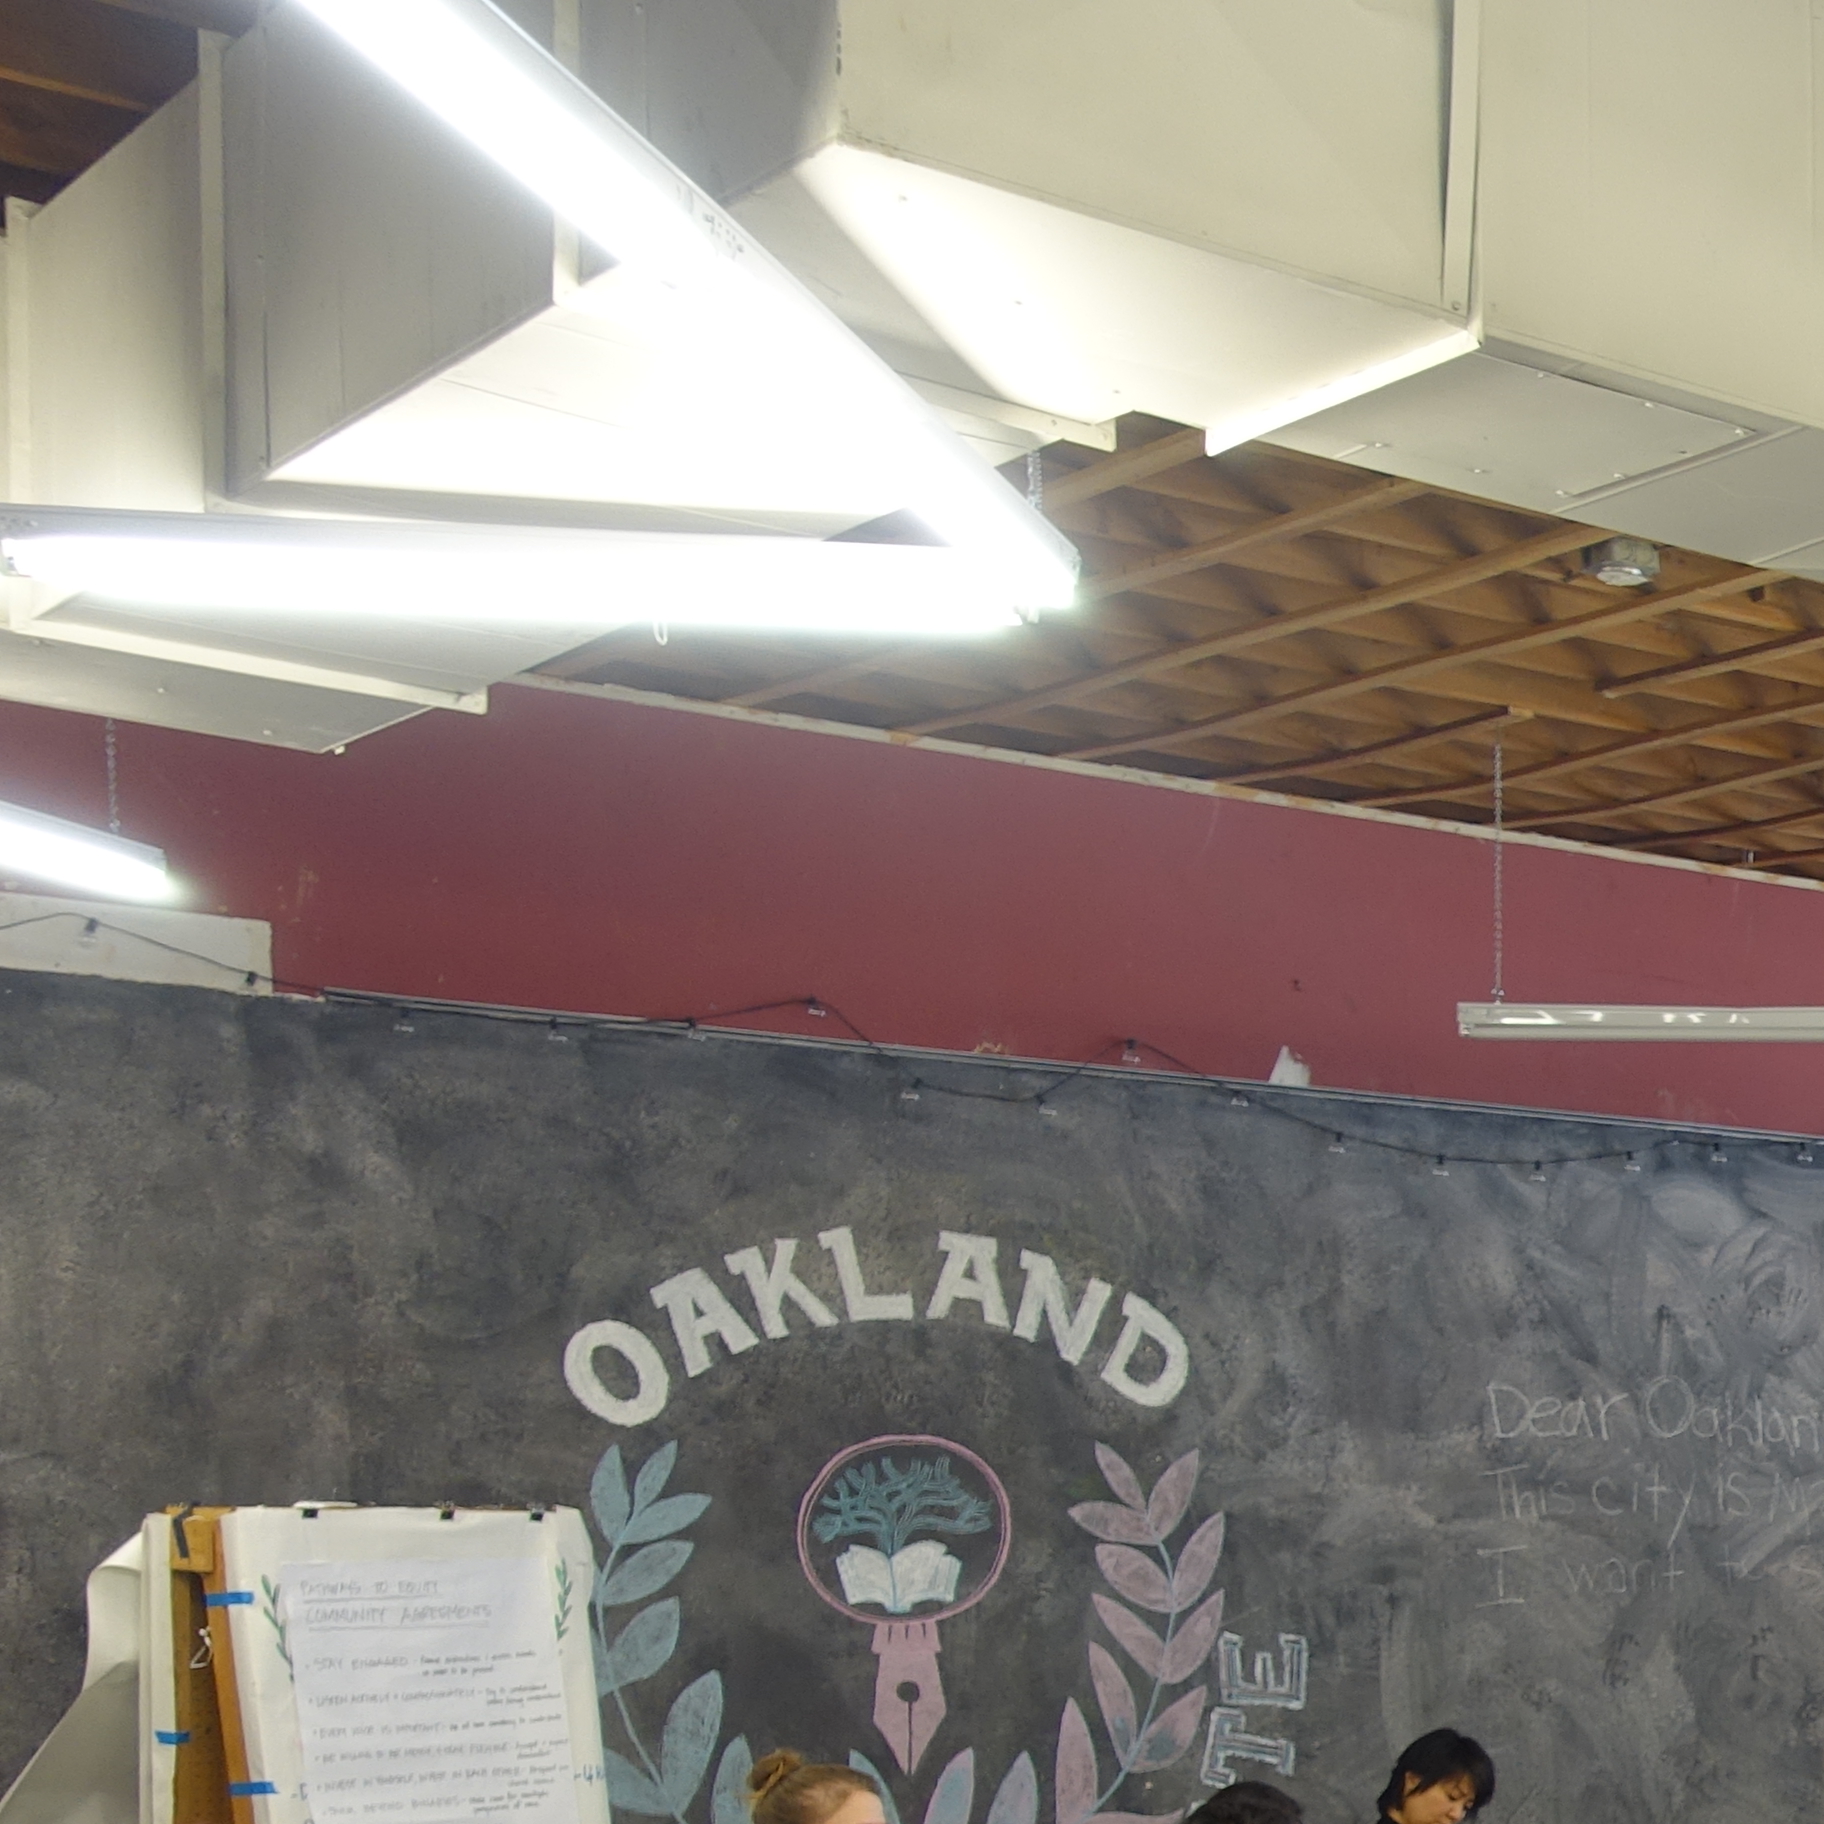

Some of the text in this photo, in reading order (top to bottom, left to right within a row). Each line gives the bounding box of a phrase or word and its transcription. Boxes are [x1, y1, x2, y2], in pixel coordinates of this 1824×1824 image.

[563, 1225, 1190, 1428] OAKLAND
[1485, 1384, 1629, 1440] Dear
[1483, 1463, 1576, 1524] This
[1475, 1543, 1530, 1606] I
[1560, 1546, 1687, 1595] want
[304, 1606, 387, 1623] COMMUNITY
